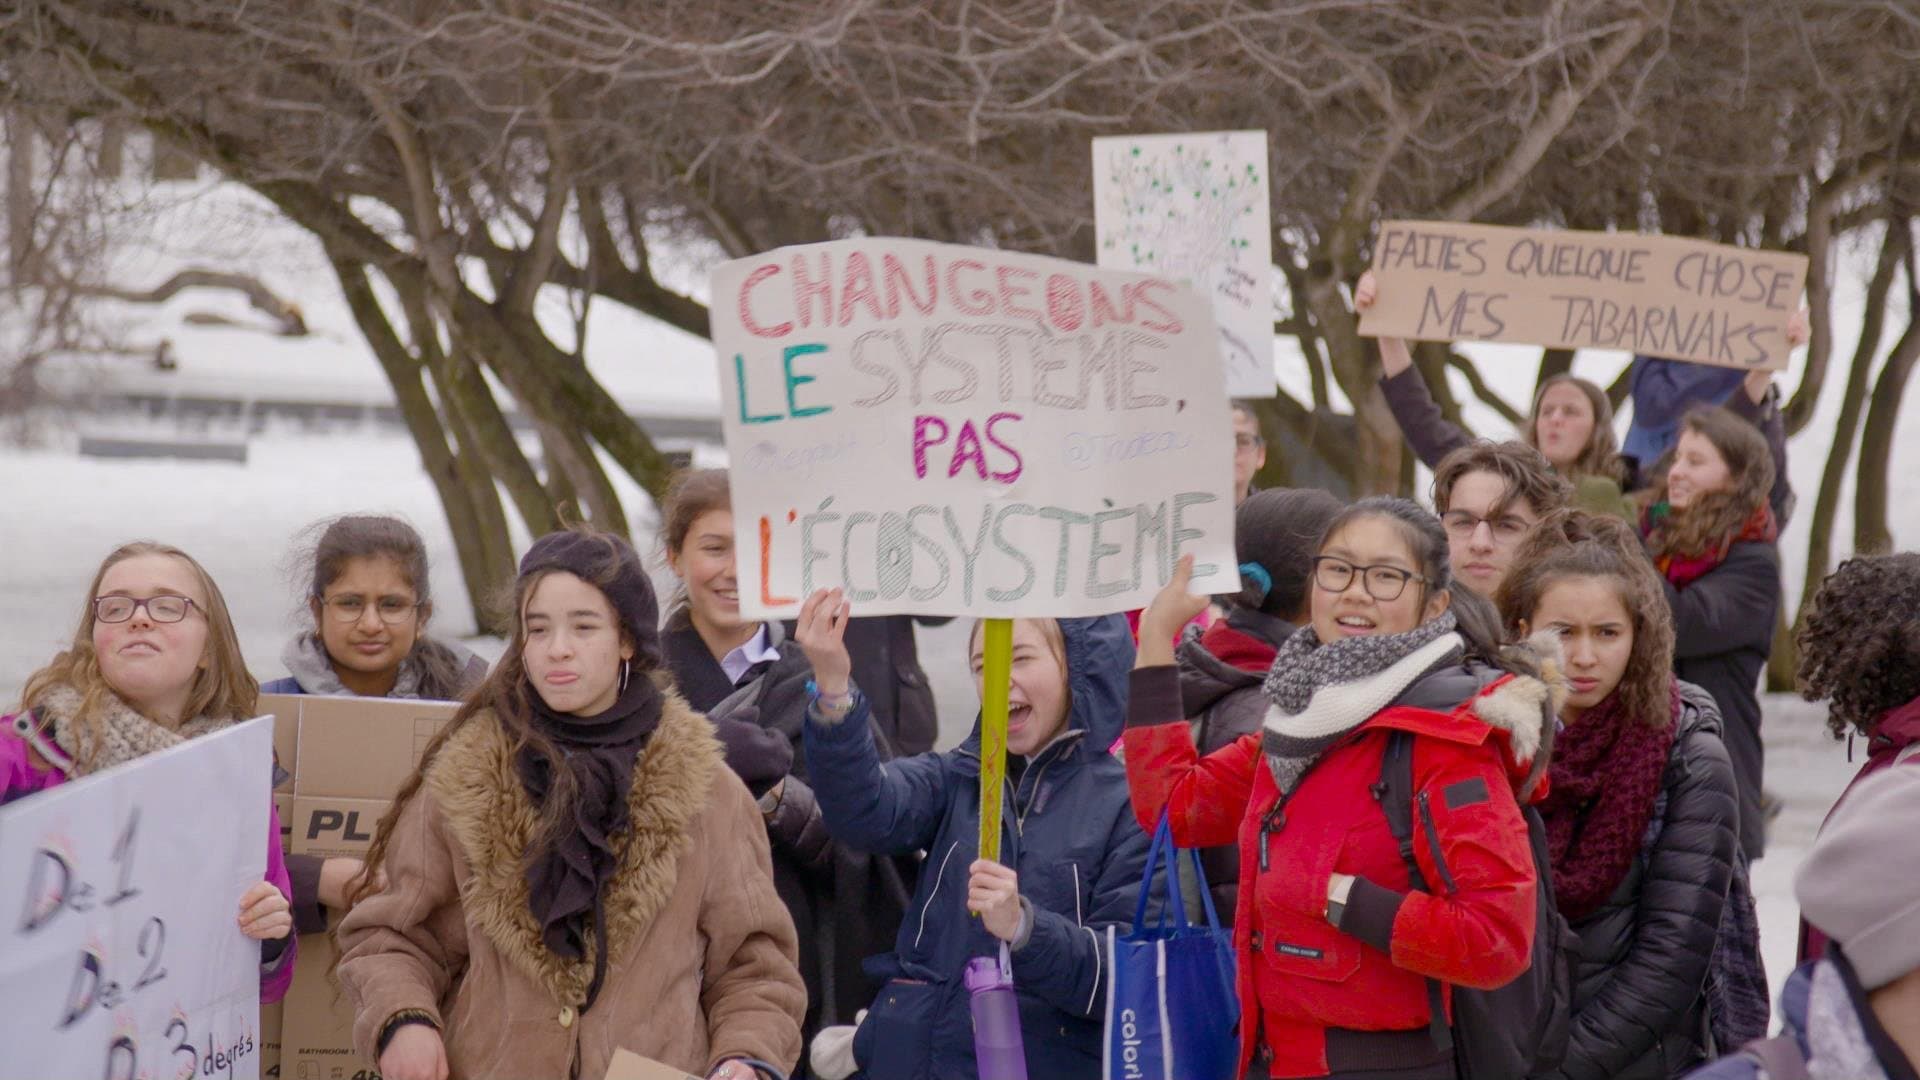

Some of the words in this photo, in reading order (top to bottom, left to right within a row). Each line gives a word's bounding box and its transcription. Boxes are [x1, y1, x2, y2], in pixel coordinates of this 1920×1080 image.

[738, 250, 1183, 338] CHANGEONS
[1380, 231, 1487, 276] FAITES
[1506, 238, 1651, 283] QUELQUE
[1674, 252, 1795, 311] CHOSE
[1416, 287, 1508, 340] MES
[1551, 294, 1777, 366] TABARNAKS
[735, 343, 832, 424] LE
[912, 412, 1024, 484] PAS
[759, 493, 1220, 609] L'ÉCOSYSTÈME
[103, 803, 143, 906] 1
[306, 809, 372, 841] PL
[132, 916, 168, 990] 2
[164, 1017, 199, 1080] 3
[203, 1031, 254, 1080] degrés
